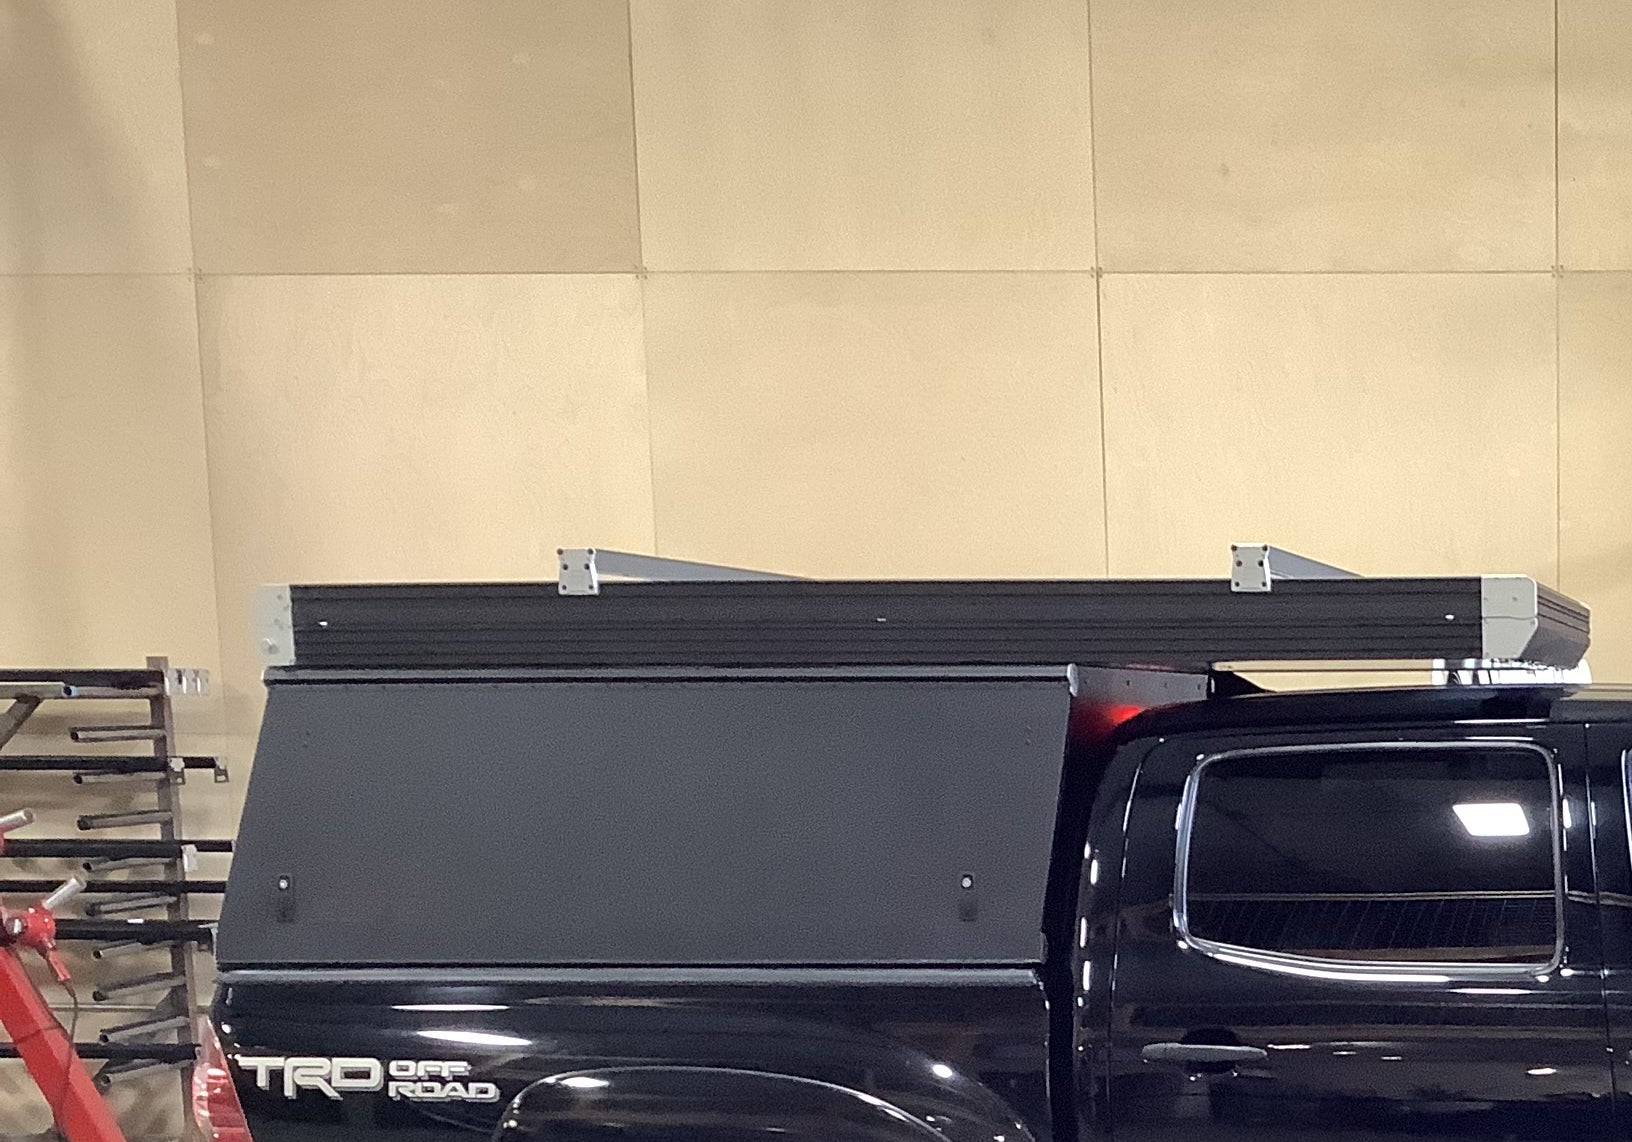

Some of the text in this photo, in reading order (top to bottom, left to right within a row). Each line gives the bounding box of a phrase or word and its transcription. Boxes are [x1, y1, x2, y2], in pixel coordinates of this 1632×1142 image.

[238, 1057, 384, 1100] TRD
[389, 1060, 472, 1080] OFF
[389, 1081, 501, 1103] ROAD
